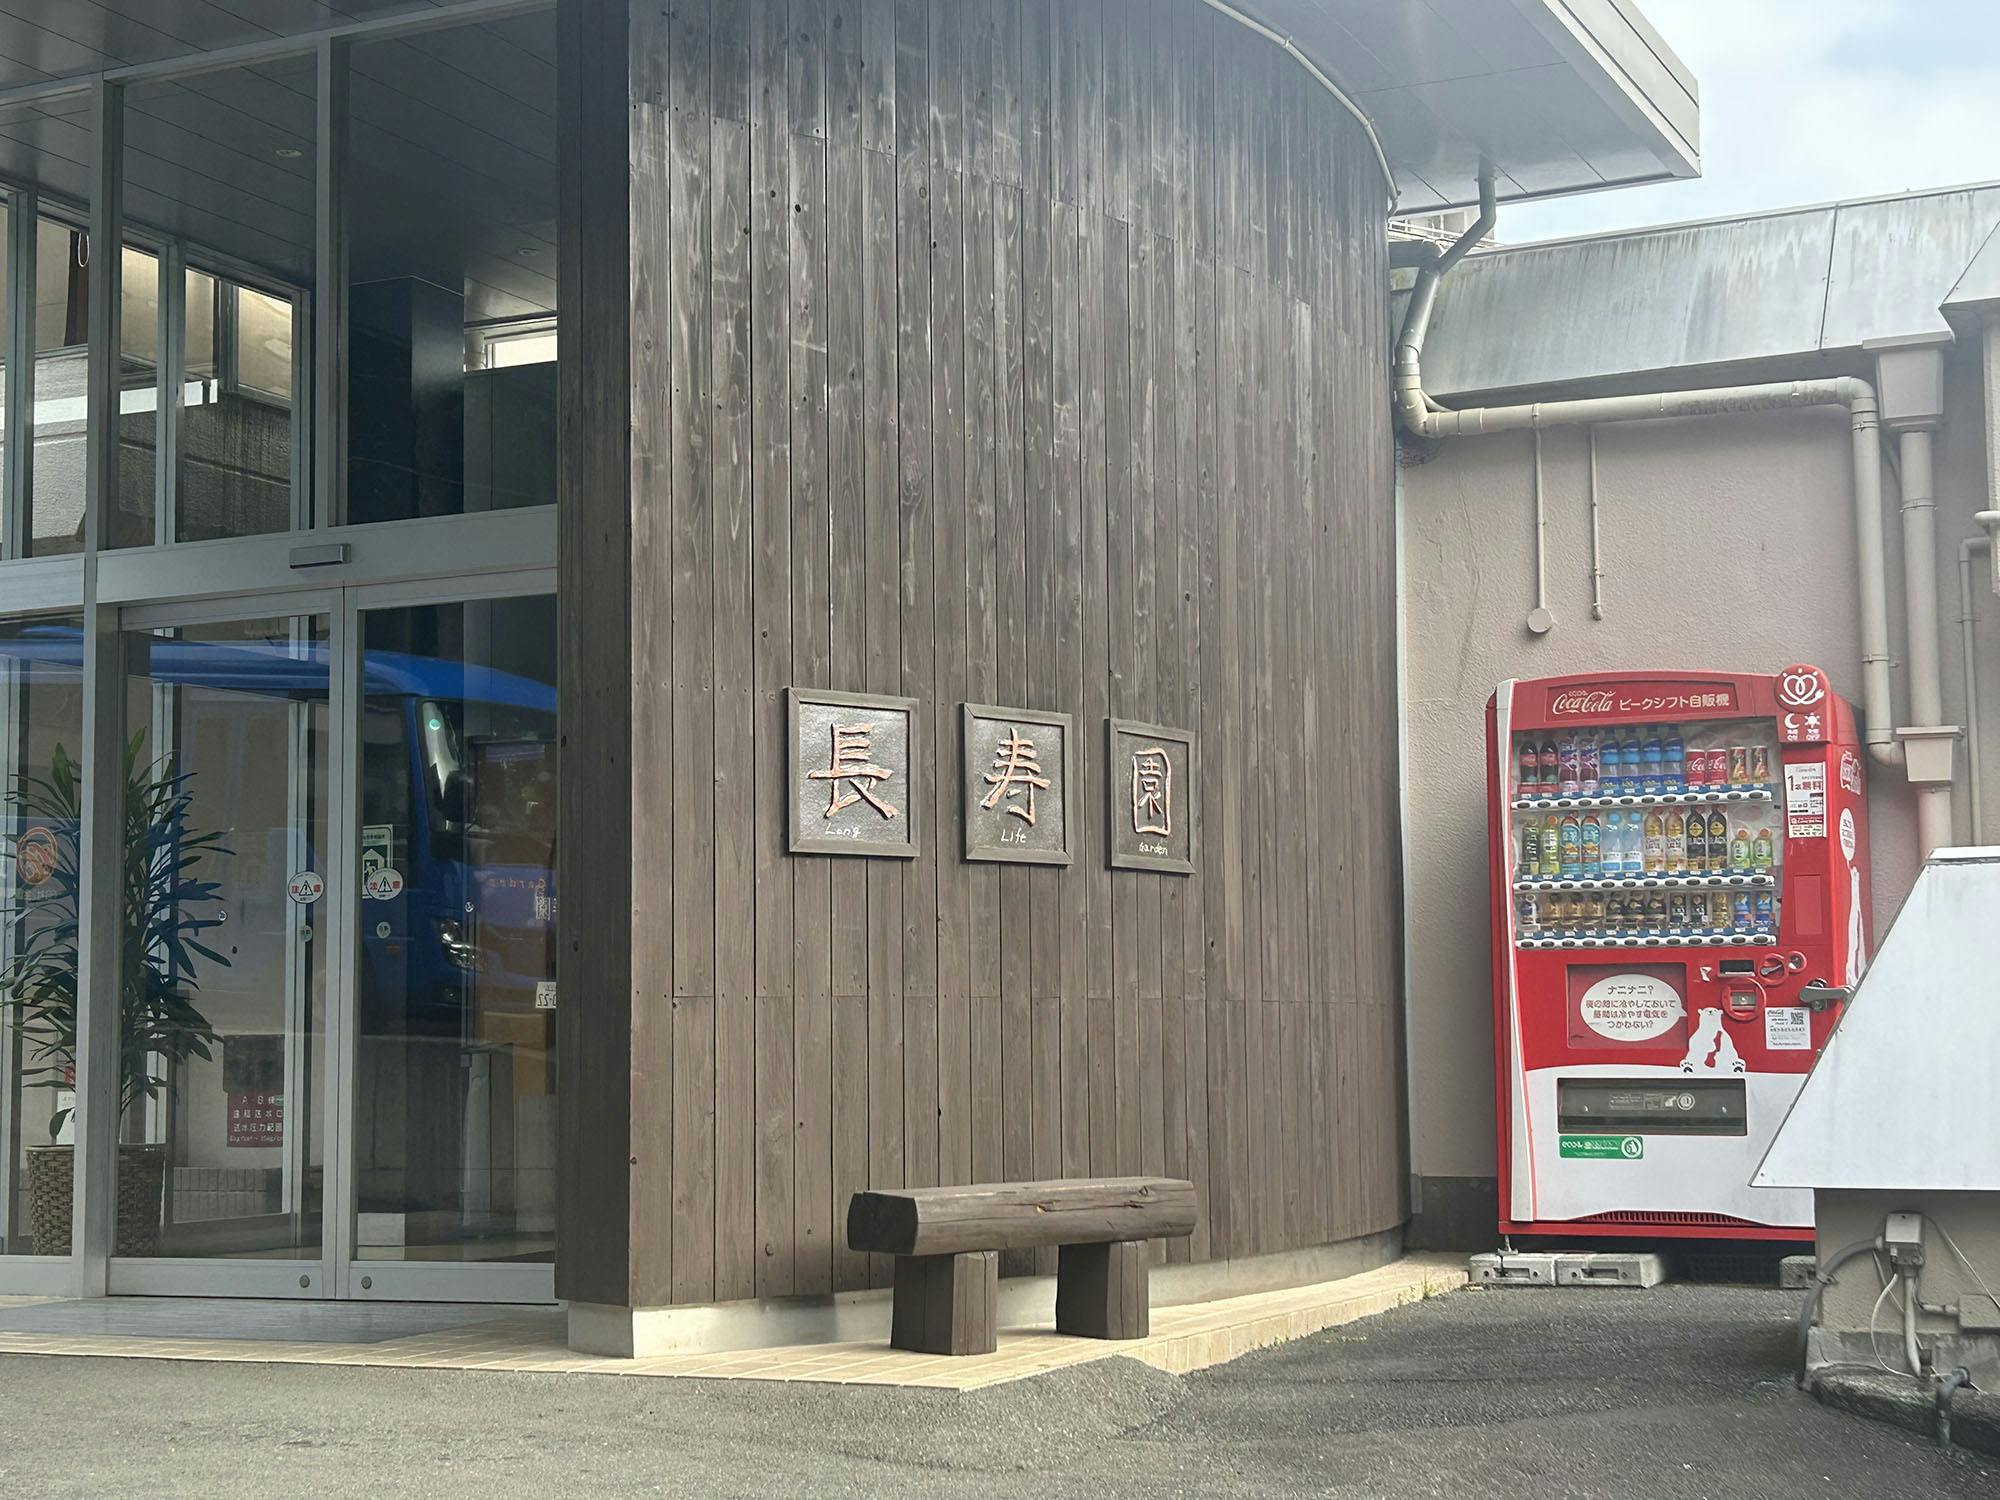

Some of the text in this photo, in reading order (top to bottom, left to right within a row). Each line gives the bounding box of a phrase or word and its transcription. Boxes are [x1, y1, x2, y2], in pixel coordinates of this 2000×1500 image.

[807, 723, 899, 820] 長
[979, 727, 1051, 826] 寿
[1132, 747, 1171, 836] 園
[825, 822, 862, 838] Long
[1000, 829, 1027, 844] Life
[1139, 842, 1168, 857] Garden
